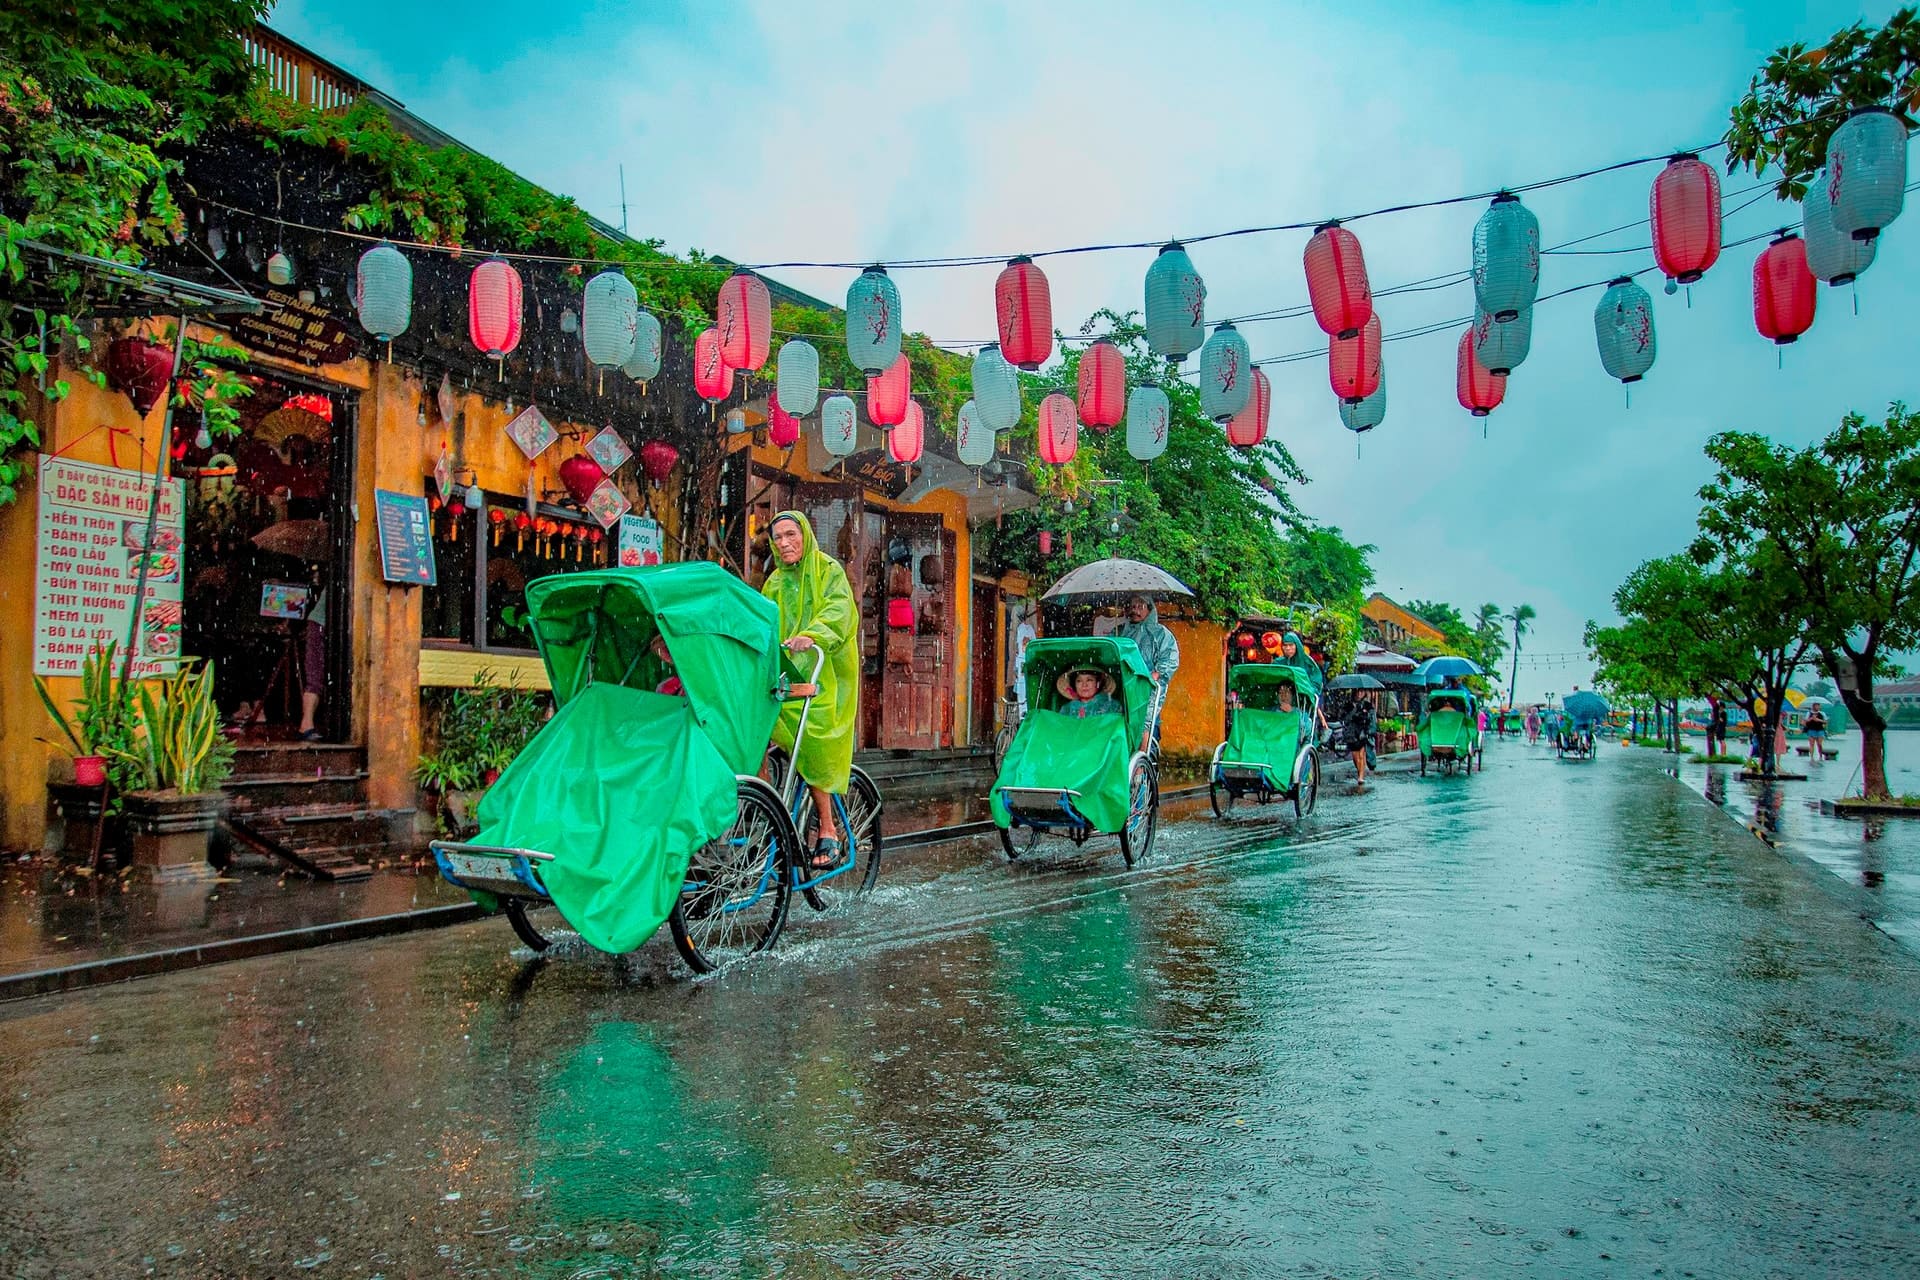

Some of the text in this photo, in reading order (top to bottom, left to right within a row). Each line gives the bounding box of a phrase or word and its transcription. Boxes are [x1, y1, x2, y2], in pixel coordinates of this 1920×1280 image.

[266, 289, 331, 318] RESTAURANT
[240, 317, 330, 351] COMMERCIAL PORT
[57, 484, 86, 503] ĐẶC
[92, 489, 120, 507] SẢN
[51, 528, 87, 543] BÁNH
[633, 533, 650, 545] FOOD
[51, 545, 78, 558] CAO
[50, 576, 77, 590] BÚN
[49, 610, 79, 622] NEM
[48, 641, 83, 654] BÁNH
[47, 659, 77, 670] NEM
